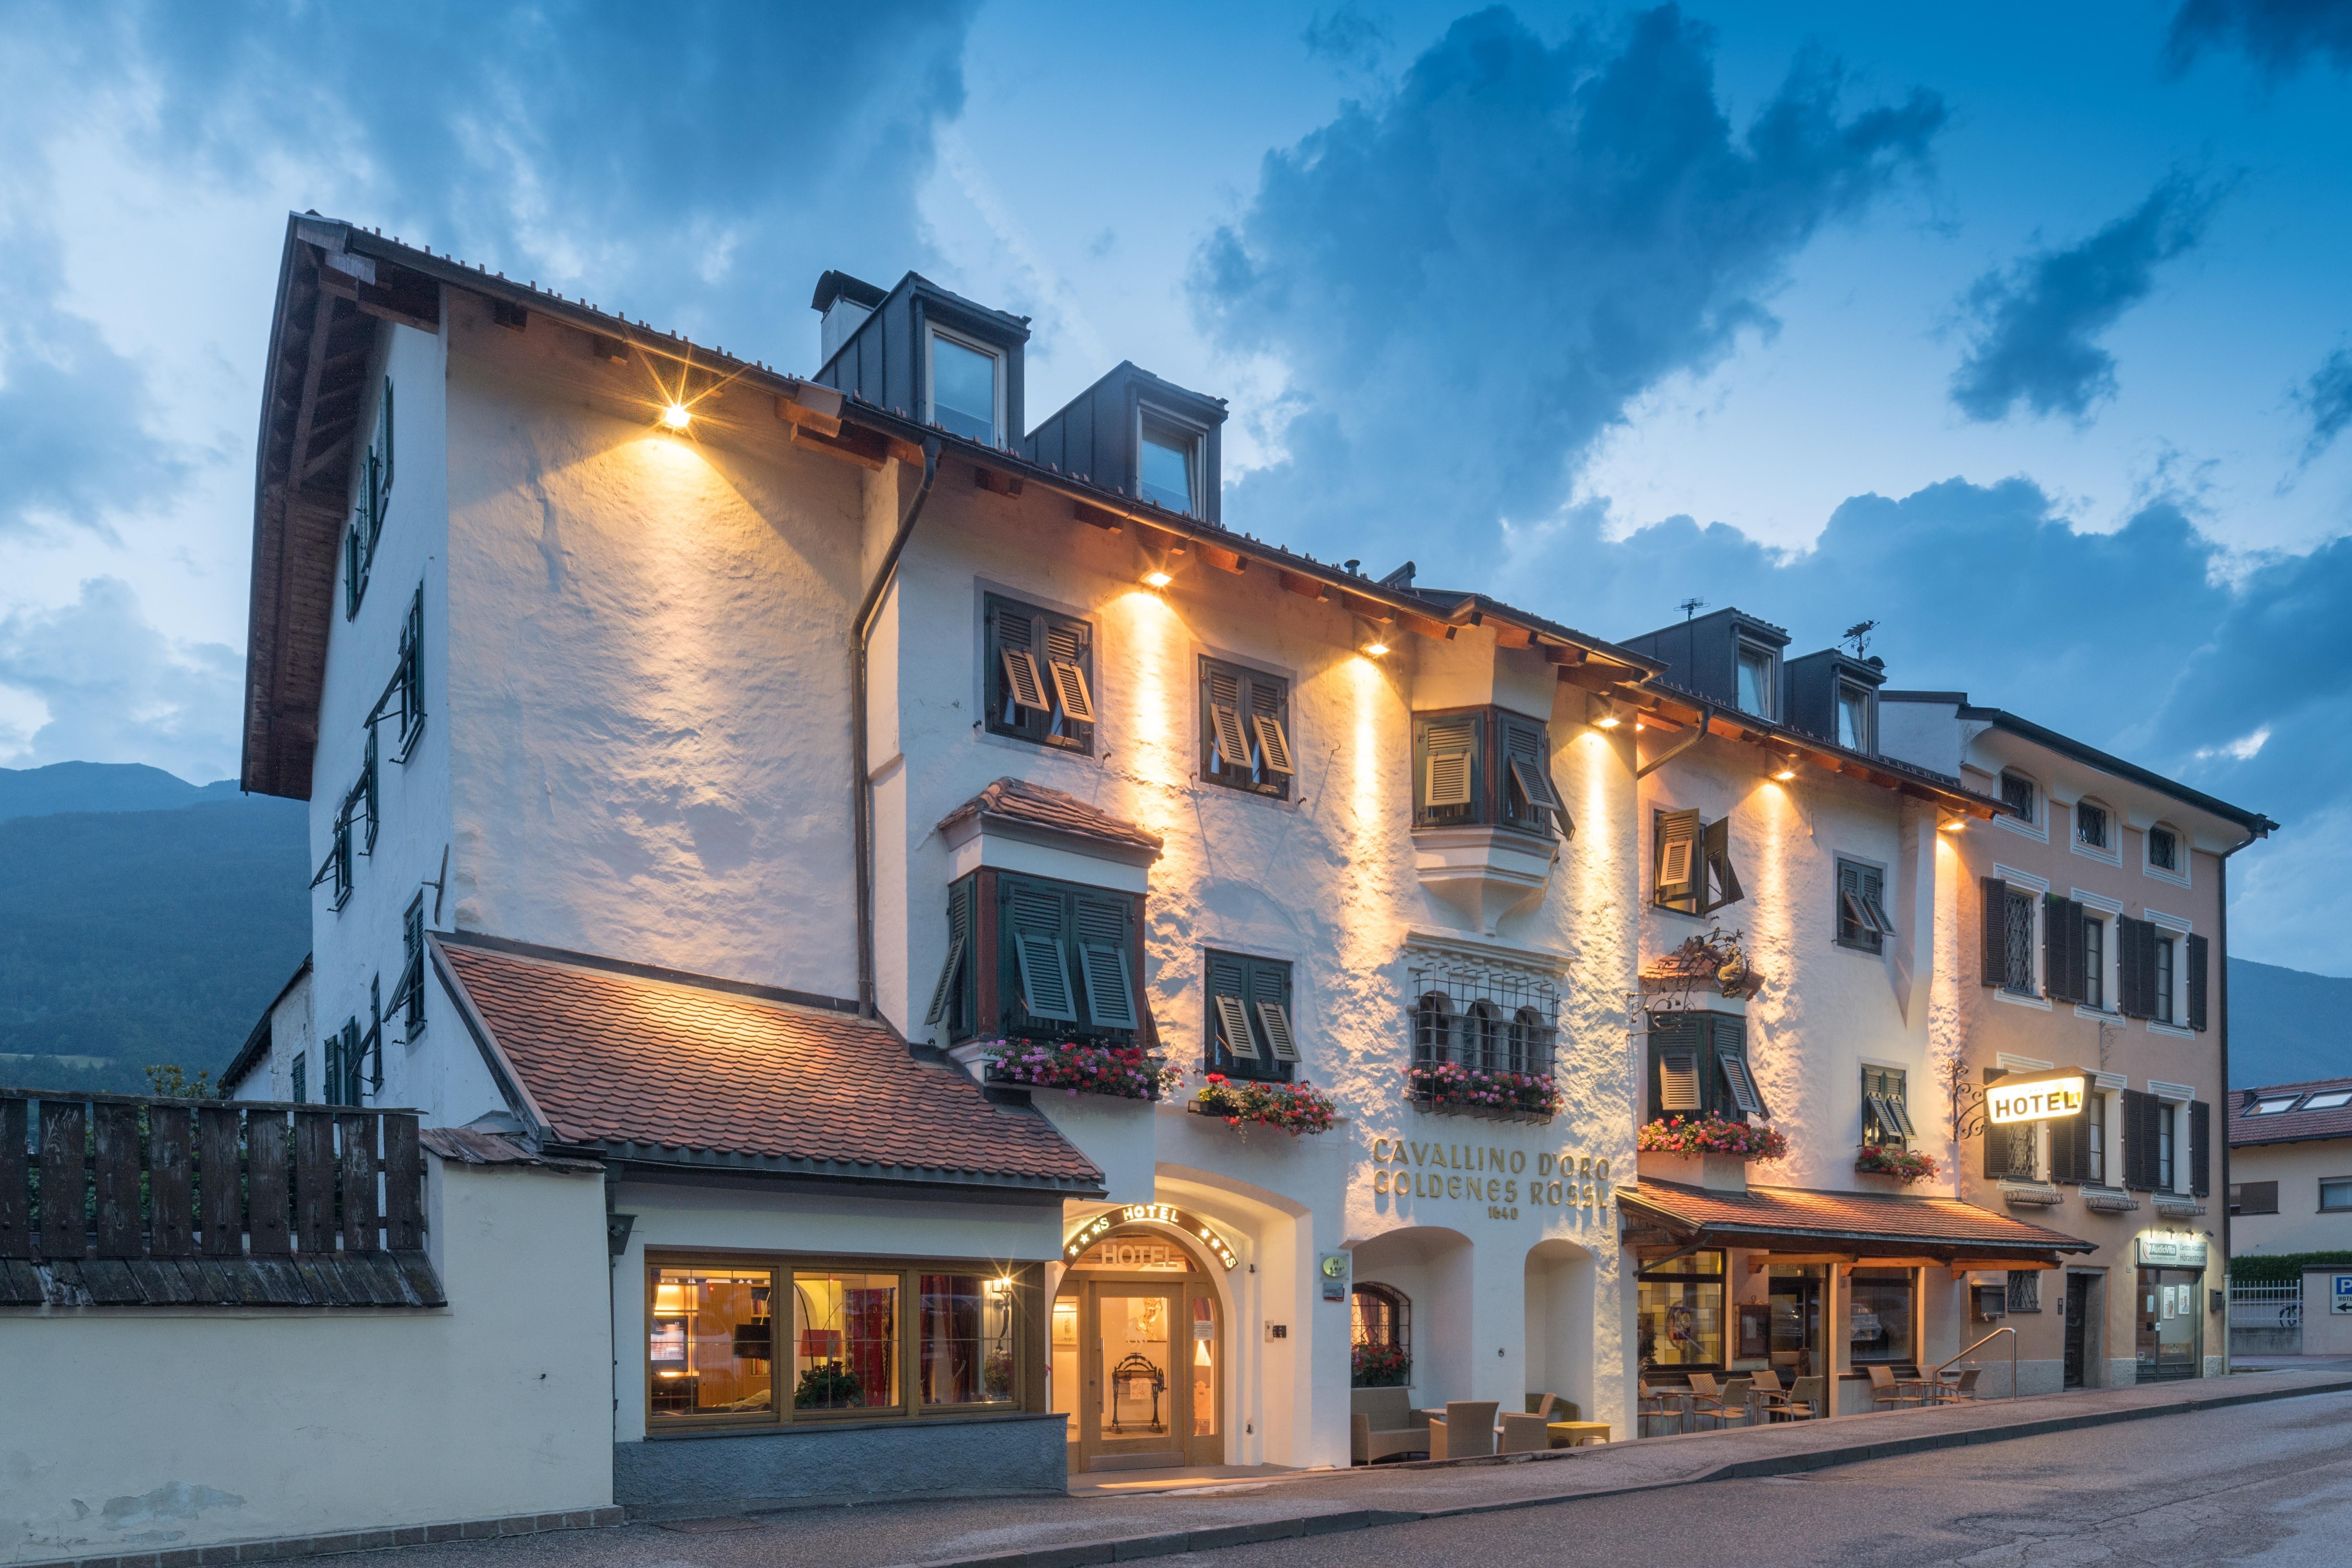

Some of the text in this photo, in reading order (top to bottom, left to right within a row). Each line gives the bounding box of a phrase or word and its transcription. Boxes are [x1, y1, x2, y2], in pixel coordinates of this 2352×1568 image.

[1996, 1091, 2078, 1118] HOTEL
[1374, 1138, 1609, 1180] CAVALLINO D'ORO
[1374, 1170, 1607, 1208] GOLDENES RÖSSL
[1122, 1205, 1179, 1222] HOTEL
[1488, 1206, 1519, 1220] 1640
[1101, 1245, 1177, 1268] HOTEL
[2151, 1245, 2176, 1254] AudioVita
[2180, 1254, 2205, 1262] Hörzentrum
[2341, 1279, 2352, 1292] P
